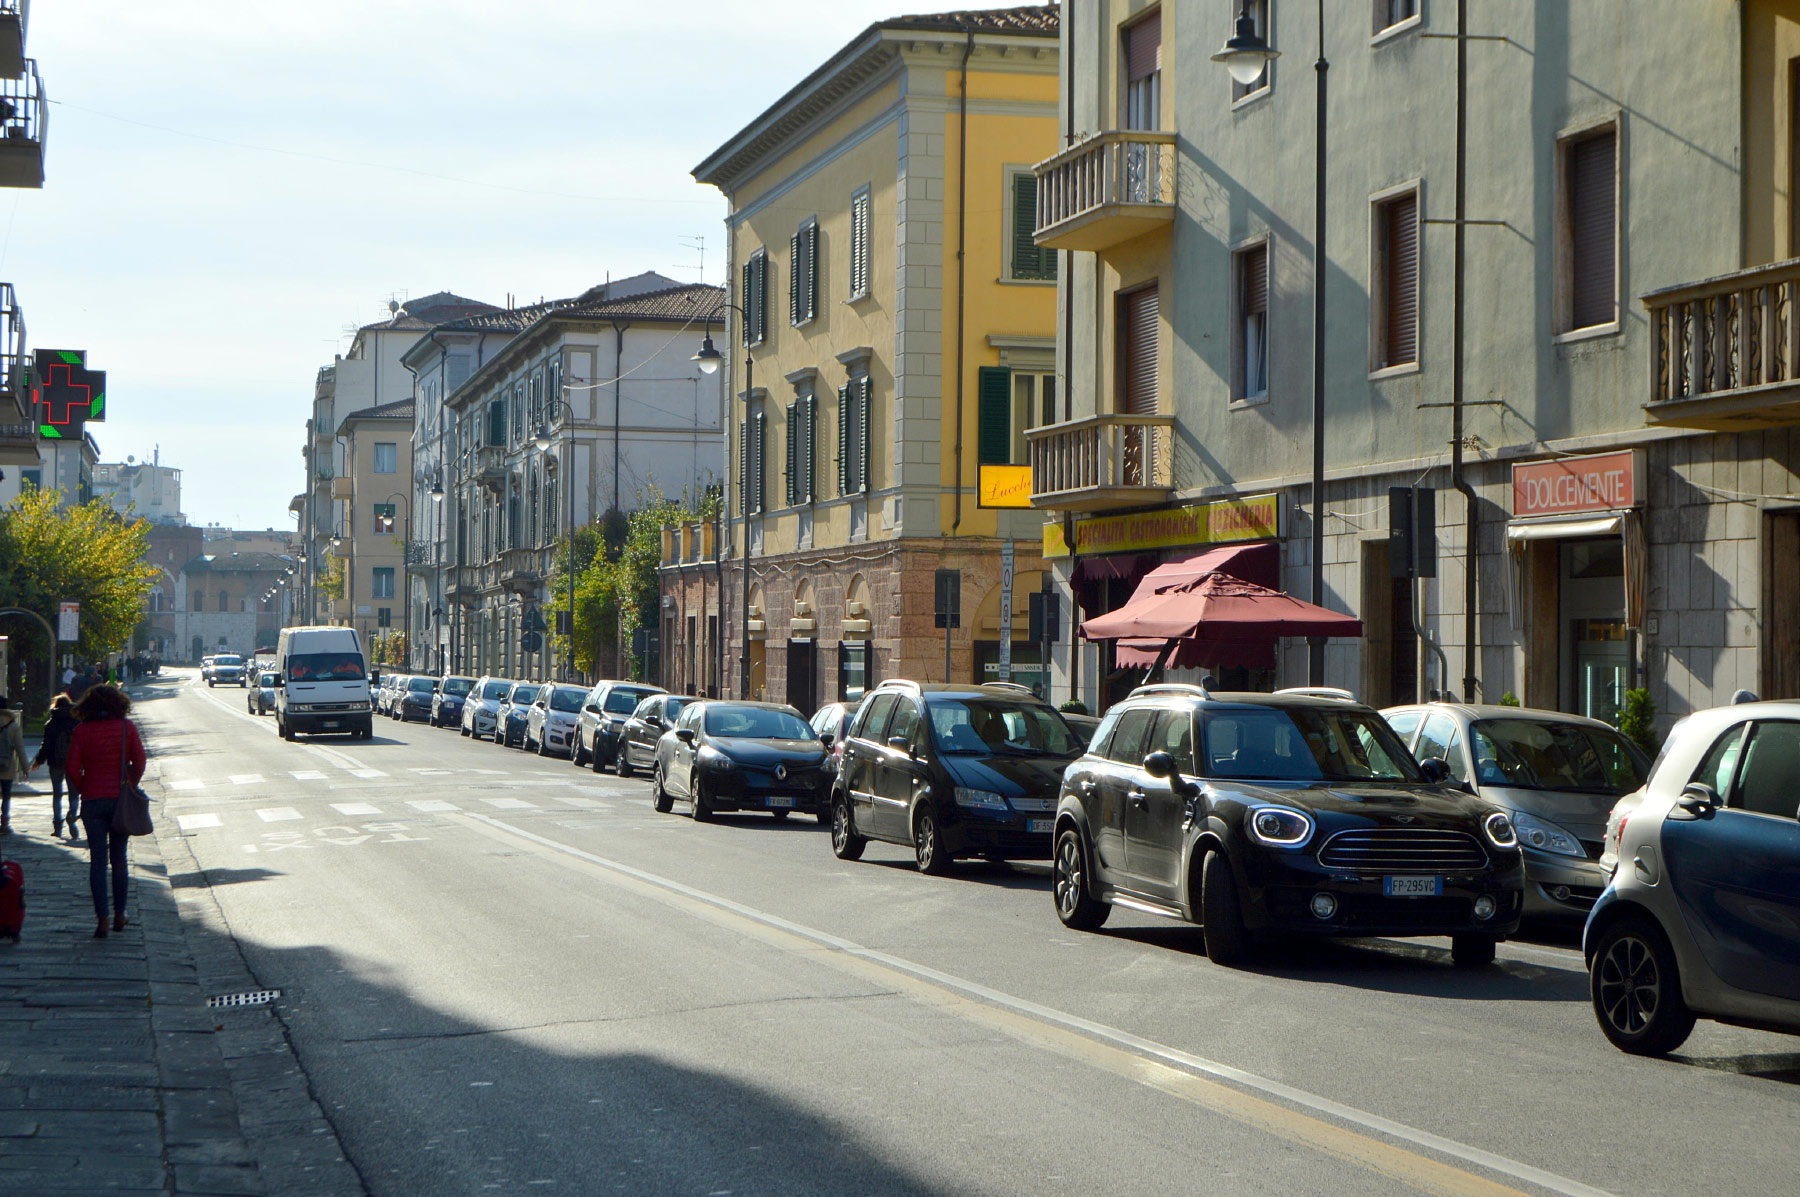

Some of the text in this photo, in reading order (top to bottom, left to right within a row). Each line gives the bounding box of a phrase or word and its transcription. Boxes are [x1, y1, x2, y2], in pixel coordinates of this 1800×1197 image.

[1527, 470, 1625, 510] DOLCEMENTE
[1129, 513, 1199, 542] GASTRONOMICHE
[1205, 503, 1274, 532] PIZZICHERIA
